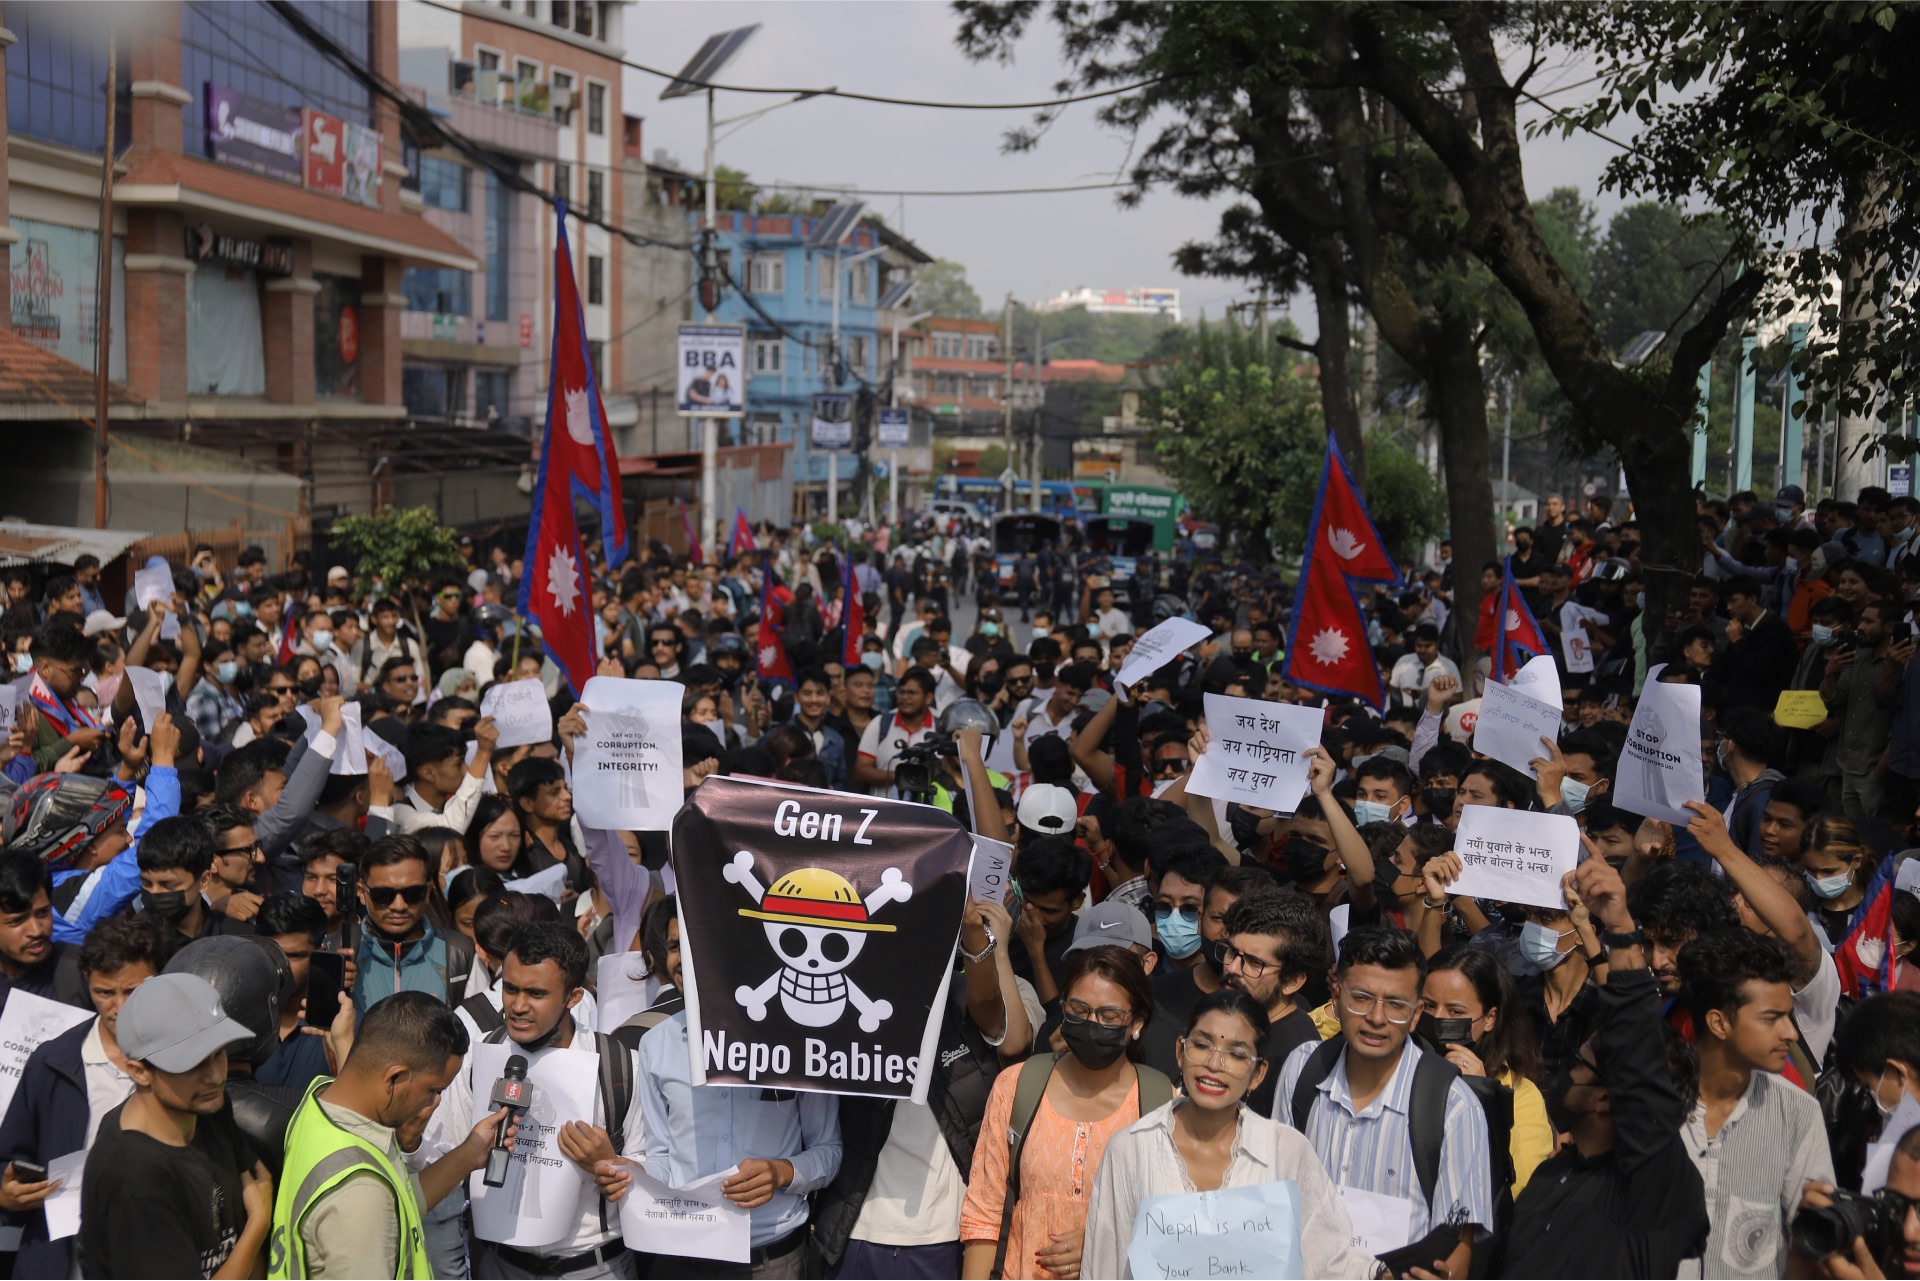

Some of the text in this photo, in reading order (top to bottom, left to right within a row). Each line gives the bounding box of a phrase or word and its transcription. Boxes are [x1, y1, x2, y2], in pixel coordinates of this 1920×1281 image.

[686, 351, 735, 368] BBA
[504, 713, 533, 726] LOGOUT
[1235, 713, 1280, 734] जय देश
[596, 741, 659, 750] CORRUPTION,
[1636, 729, 1659, 744] STOP
[1222, 739, 1296, 764] जय राष्ट्रियता
[597, 761, 659, 771] INTEGRITY!
[1648, 759, 1664, 767] STOPS
[1227, 767, 1249, 783] जय
[1251, 772, 1277, 790] युवा
[774, 799, 878, 845] Gen Z
[1466, 837, 1553, 860] नयाँ युवाले के भन्छ,
[1463, 852, 1487, 865] खुलेर
[1516, 857, 1524, 871] दे
[980, 855, 1004, 900] NOW
[3, 1040, 33, 1055] CORR
[703, 1029, 920, 1085] Nepo Babies
[684, 1200, 699, 1208] चरम
[645, 1208, 668, 1219] नेताको
[689, 1213, 704, 1221] गरम
[1145, 1211, 1274, 1243] Nepal is not
[1208, 1256, 1253, 1276] Bank
